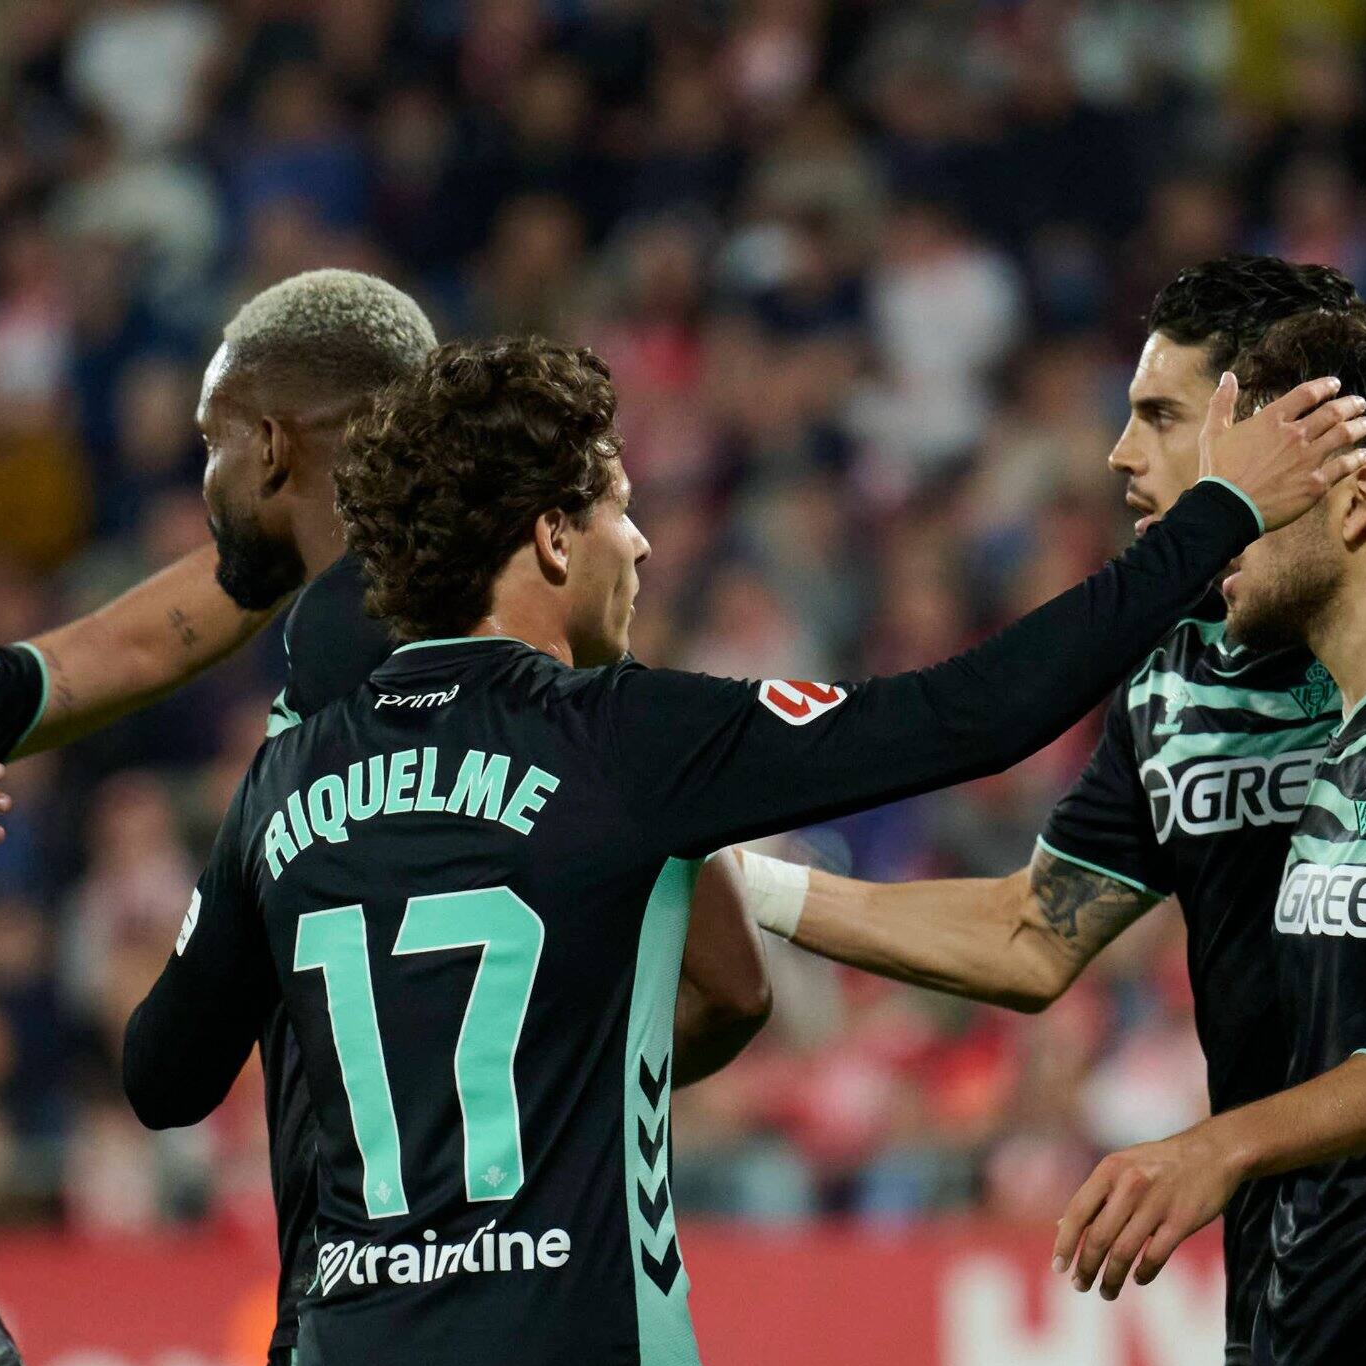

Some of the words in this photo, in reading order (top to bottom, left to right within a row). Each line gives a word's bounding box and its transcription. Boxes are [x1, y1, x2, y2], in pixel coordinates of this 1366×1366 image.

[264, 746, 561, 881] RIQUELME
[1180, 756, 1317, 826] GRE
[293, 885, 546, 1221] 17
[348, 1218, 572, 1286] trainline
